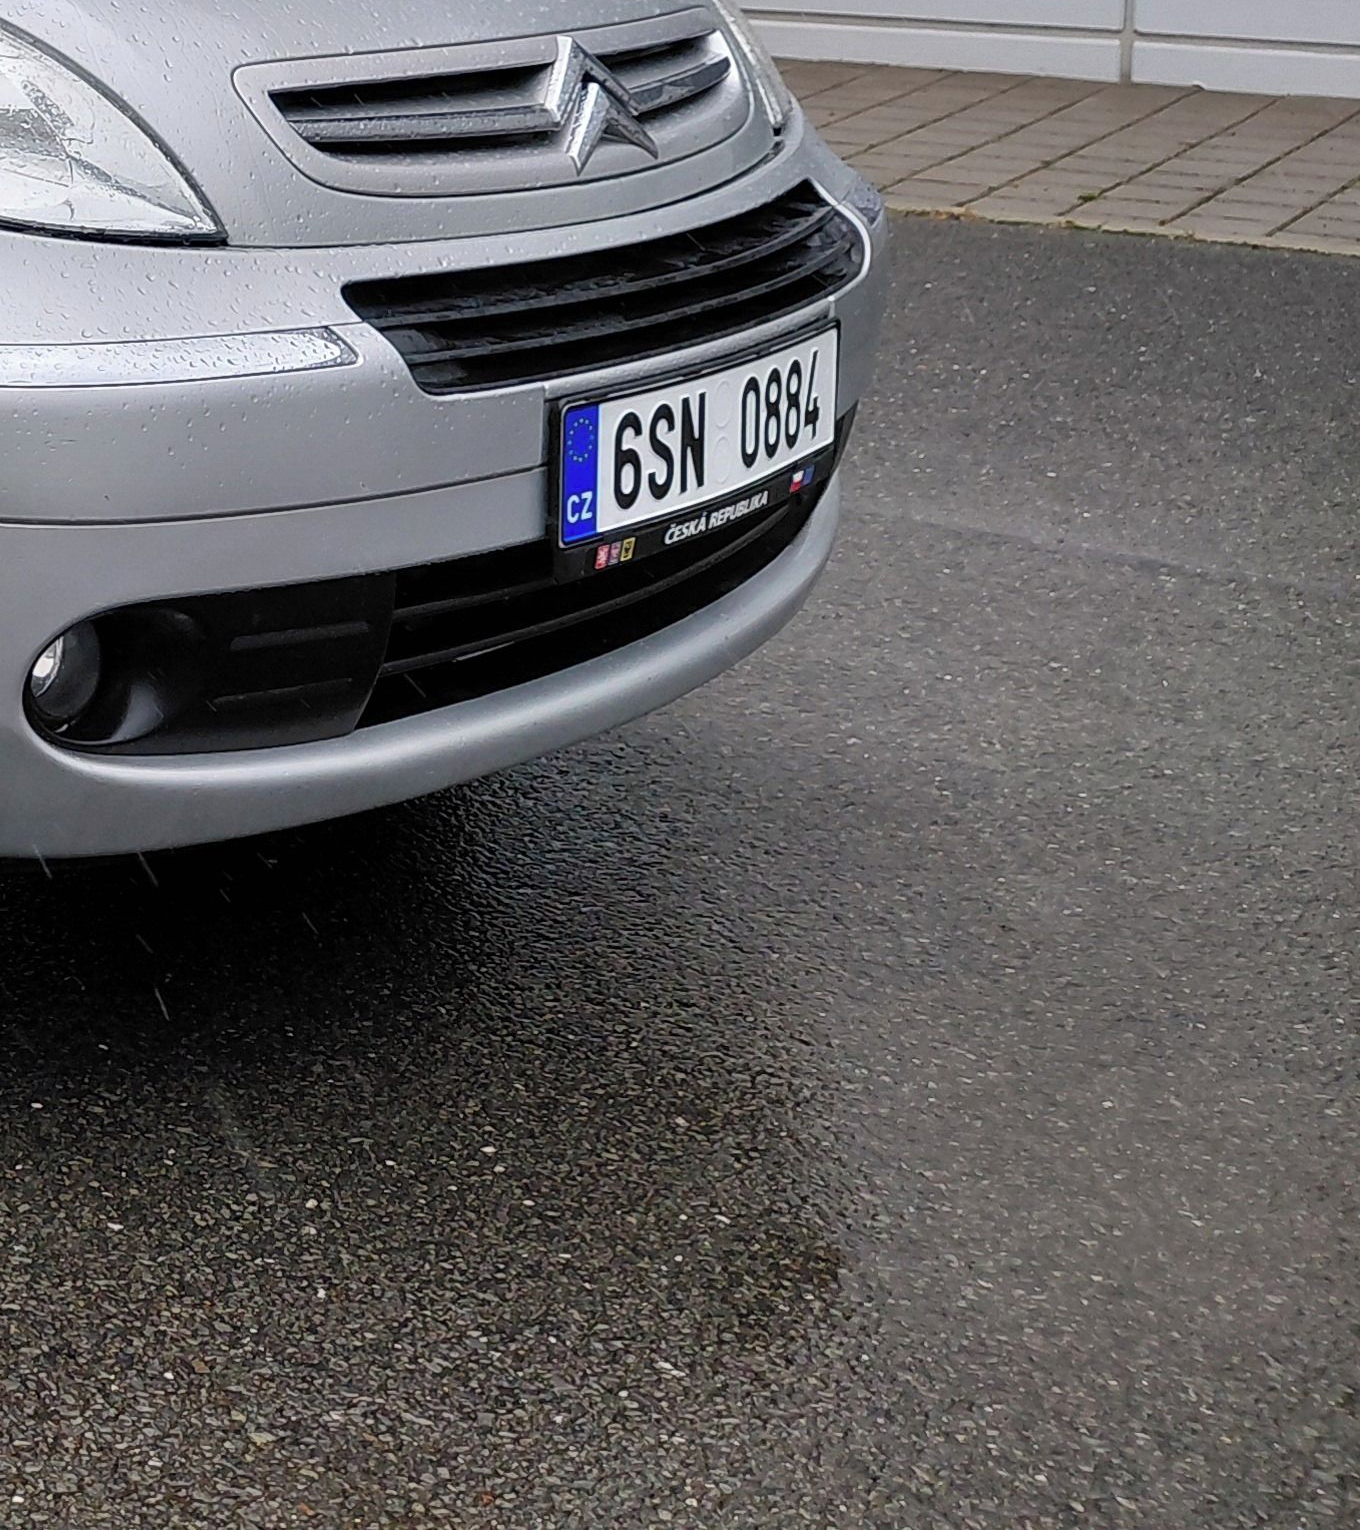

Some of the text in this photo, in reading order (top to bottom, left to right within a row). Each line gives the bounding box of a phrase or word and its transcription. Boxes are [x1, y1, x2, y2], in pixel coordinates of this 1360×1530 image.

[612, 348, 820, 510] 6SN 0884
[566, 491, 593, 524] CZ
[664, 490, 769, 545] ČESKÁ REPUBLIKA
